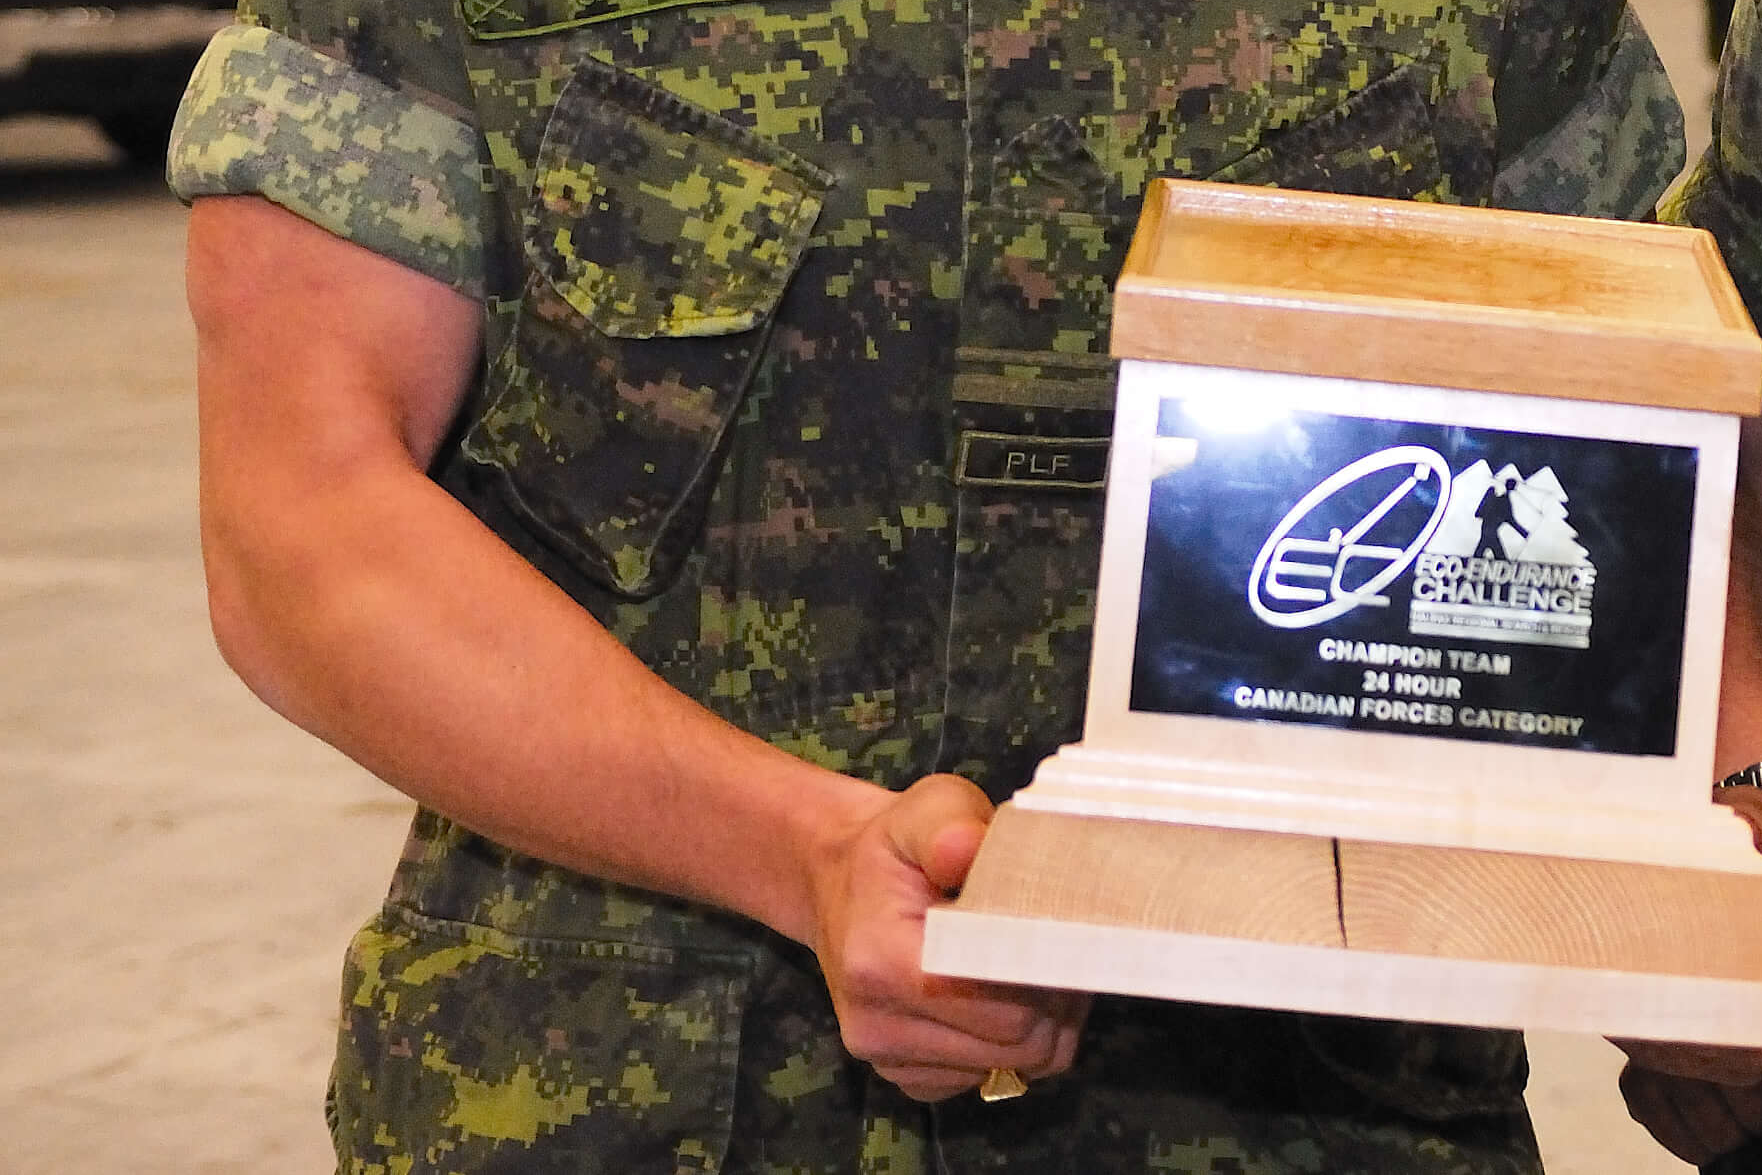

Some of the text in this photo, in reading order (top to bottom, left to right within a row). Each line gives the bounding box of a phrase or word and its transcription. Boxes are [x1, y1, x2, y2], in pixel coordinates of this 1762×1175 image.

[1414, 553, 1597, 591] ECO-ENDURANCE
[1412, 576, 1593, 615] CHALLENGE
[1318, 638, 1511, 676] CHAMPION TEAM
[1362, 670, 1462, 700] 24 HOUR
[1233, 685, 1586, 738] CANADIAN FORCES CATEGORY
